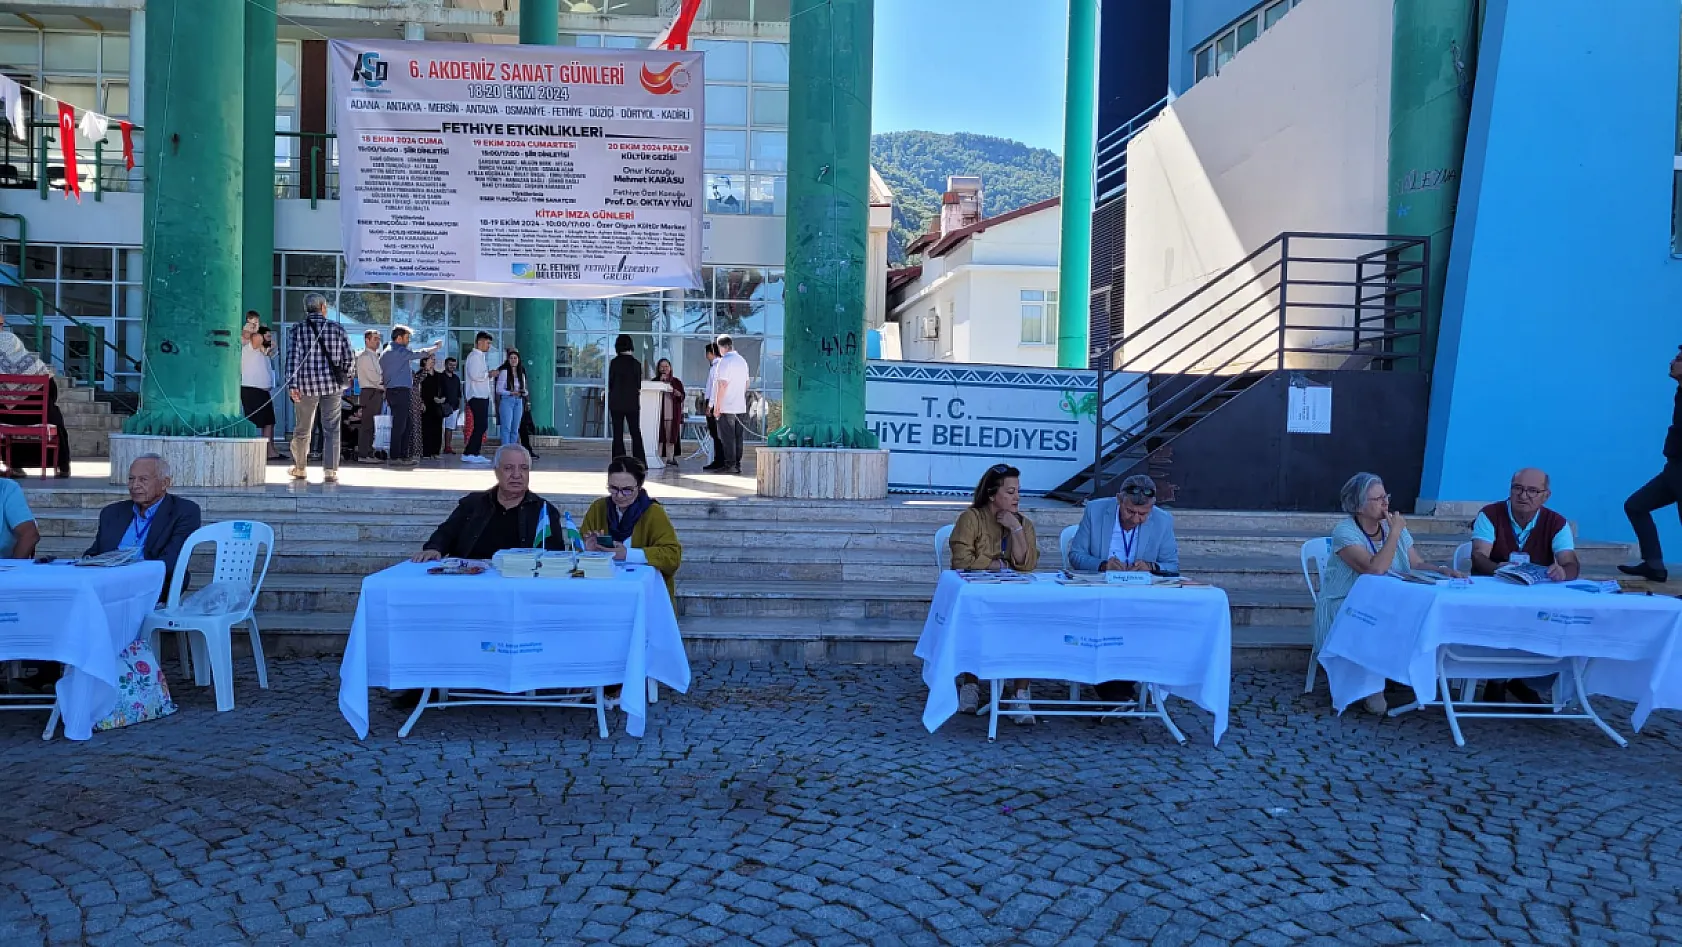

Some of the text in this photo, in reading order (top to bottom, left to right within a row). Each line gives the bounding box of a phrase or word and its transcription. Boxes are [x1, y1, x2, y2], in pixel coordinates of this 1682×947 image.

[410, 57, 624, 85] 6. AKDENİZ SANAT GÜNLERİ
[469, 84, 500, 98] 18-20
[538, 86, 569, 101] 2024
[351, 100, 380, 110] ADANA
[387, 102, 422, 112] ANTAKYA
[428, 102, 459, 112] MERSİN
[466, 104, 498, 114] ANTALYA
[505, 104, 546, 116] OSMANİYE
[552, 105, 583, 117] FETHİYE
[621, 107, 654, 120] DÖRTYOL
[649, 176, 684, 184] KARASU
[640, 199, 669, 207] OKTAY
[536, 208, 634, 220] KİTAP İMZA GÜNLERİ
